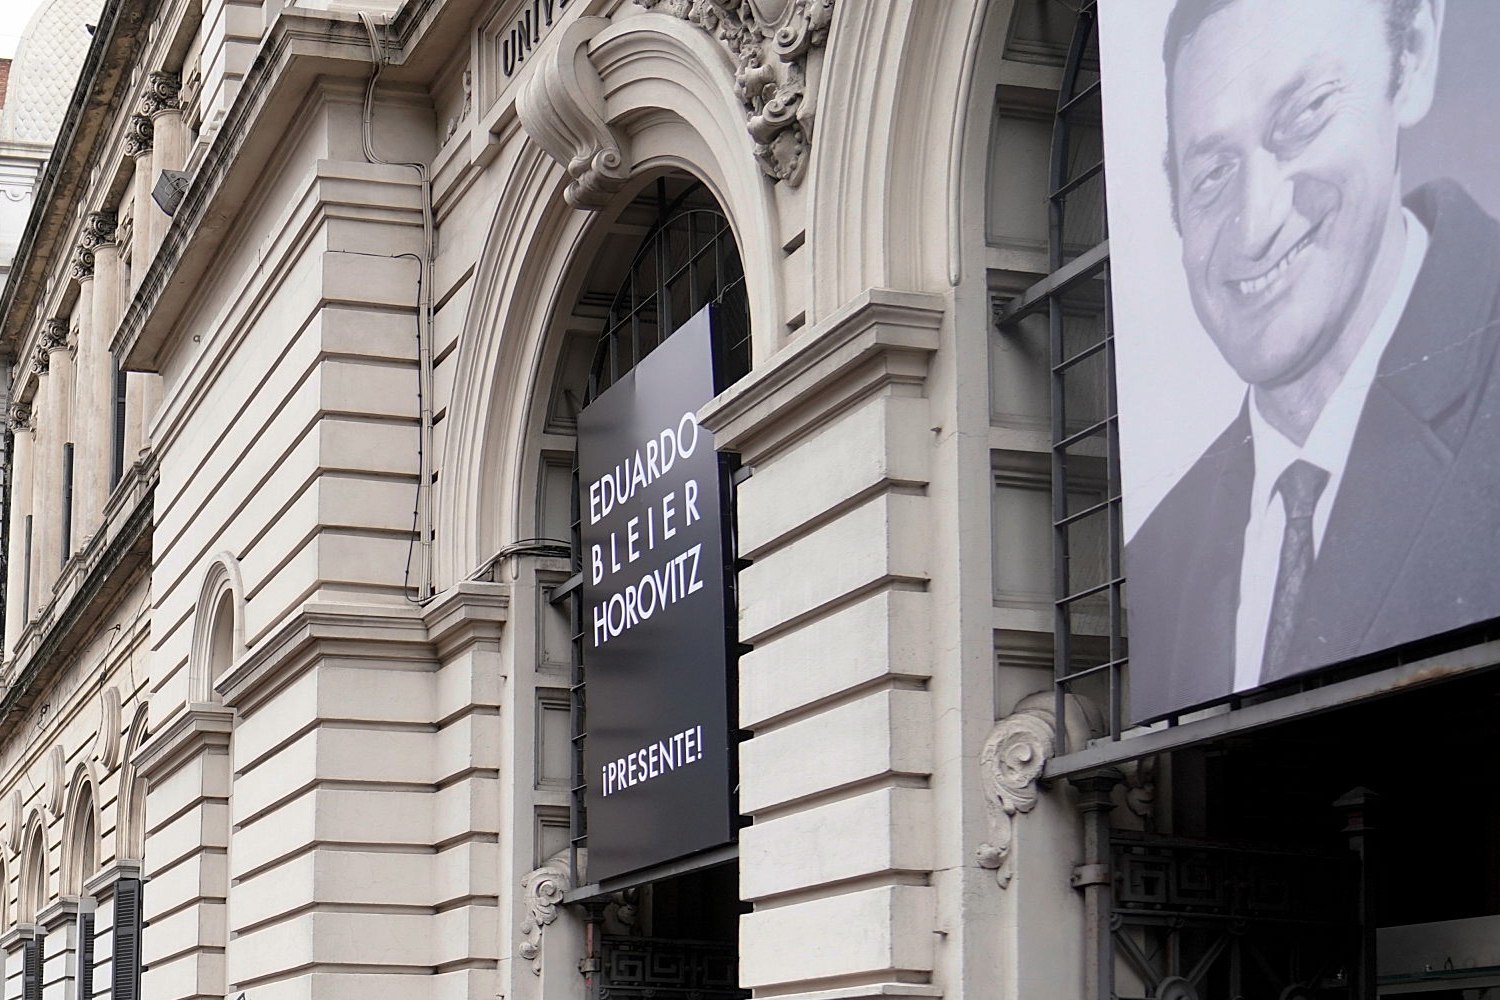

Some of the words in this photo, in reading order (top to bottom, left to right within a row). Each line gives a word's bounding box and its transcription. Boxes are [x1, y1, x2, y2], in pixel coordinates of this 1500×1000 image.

[503, 0, 568, 77] UNIV
[589, 411, 699, 525] EDUARDO
[591, 479, 701, 586] BLEIER
[593, 542, 704, 648] HOROVITZ
[601, 725, 703, 797] ¡PRESENTE!
